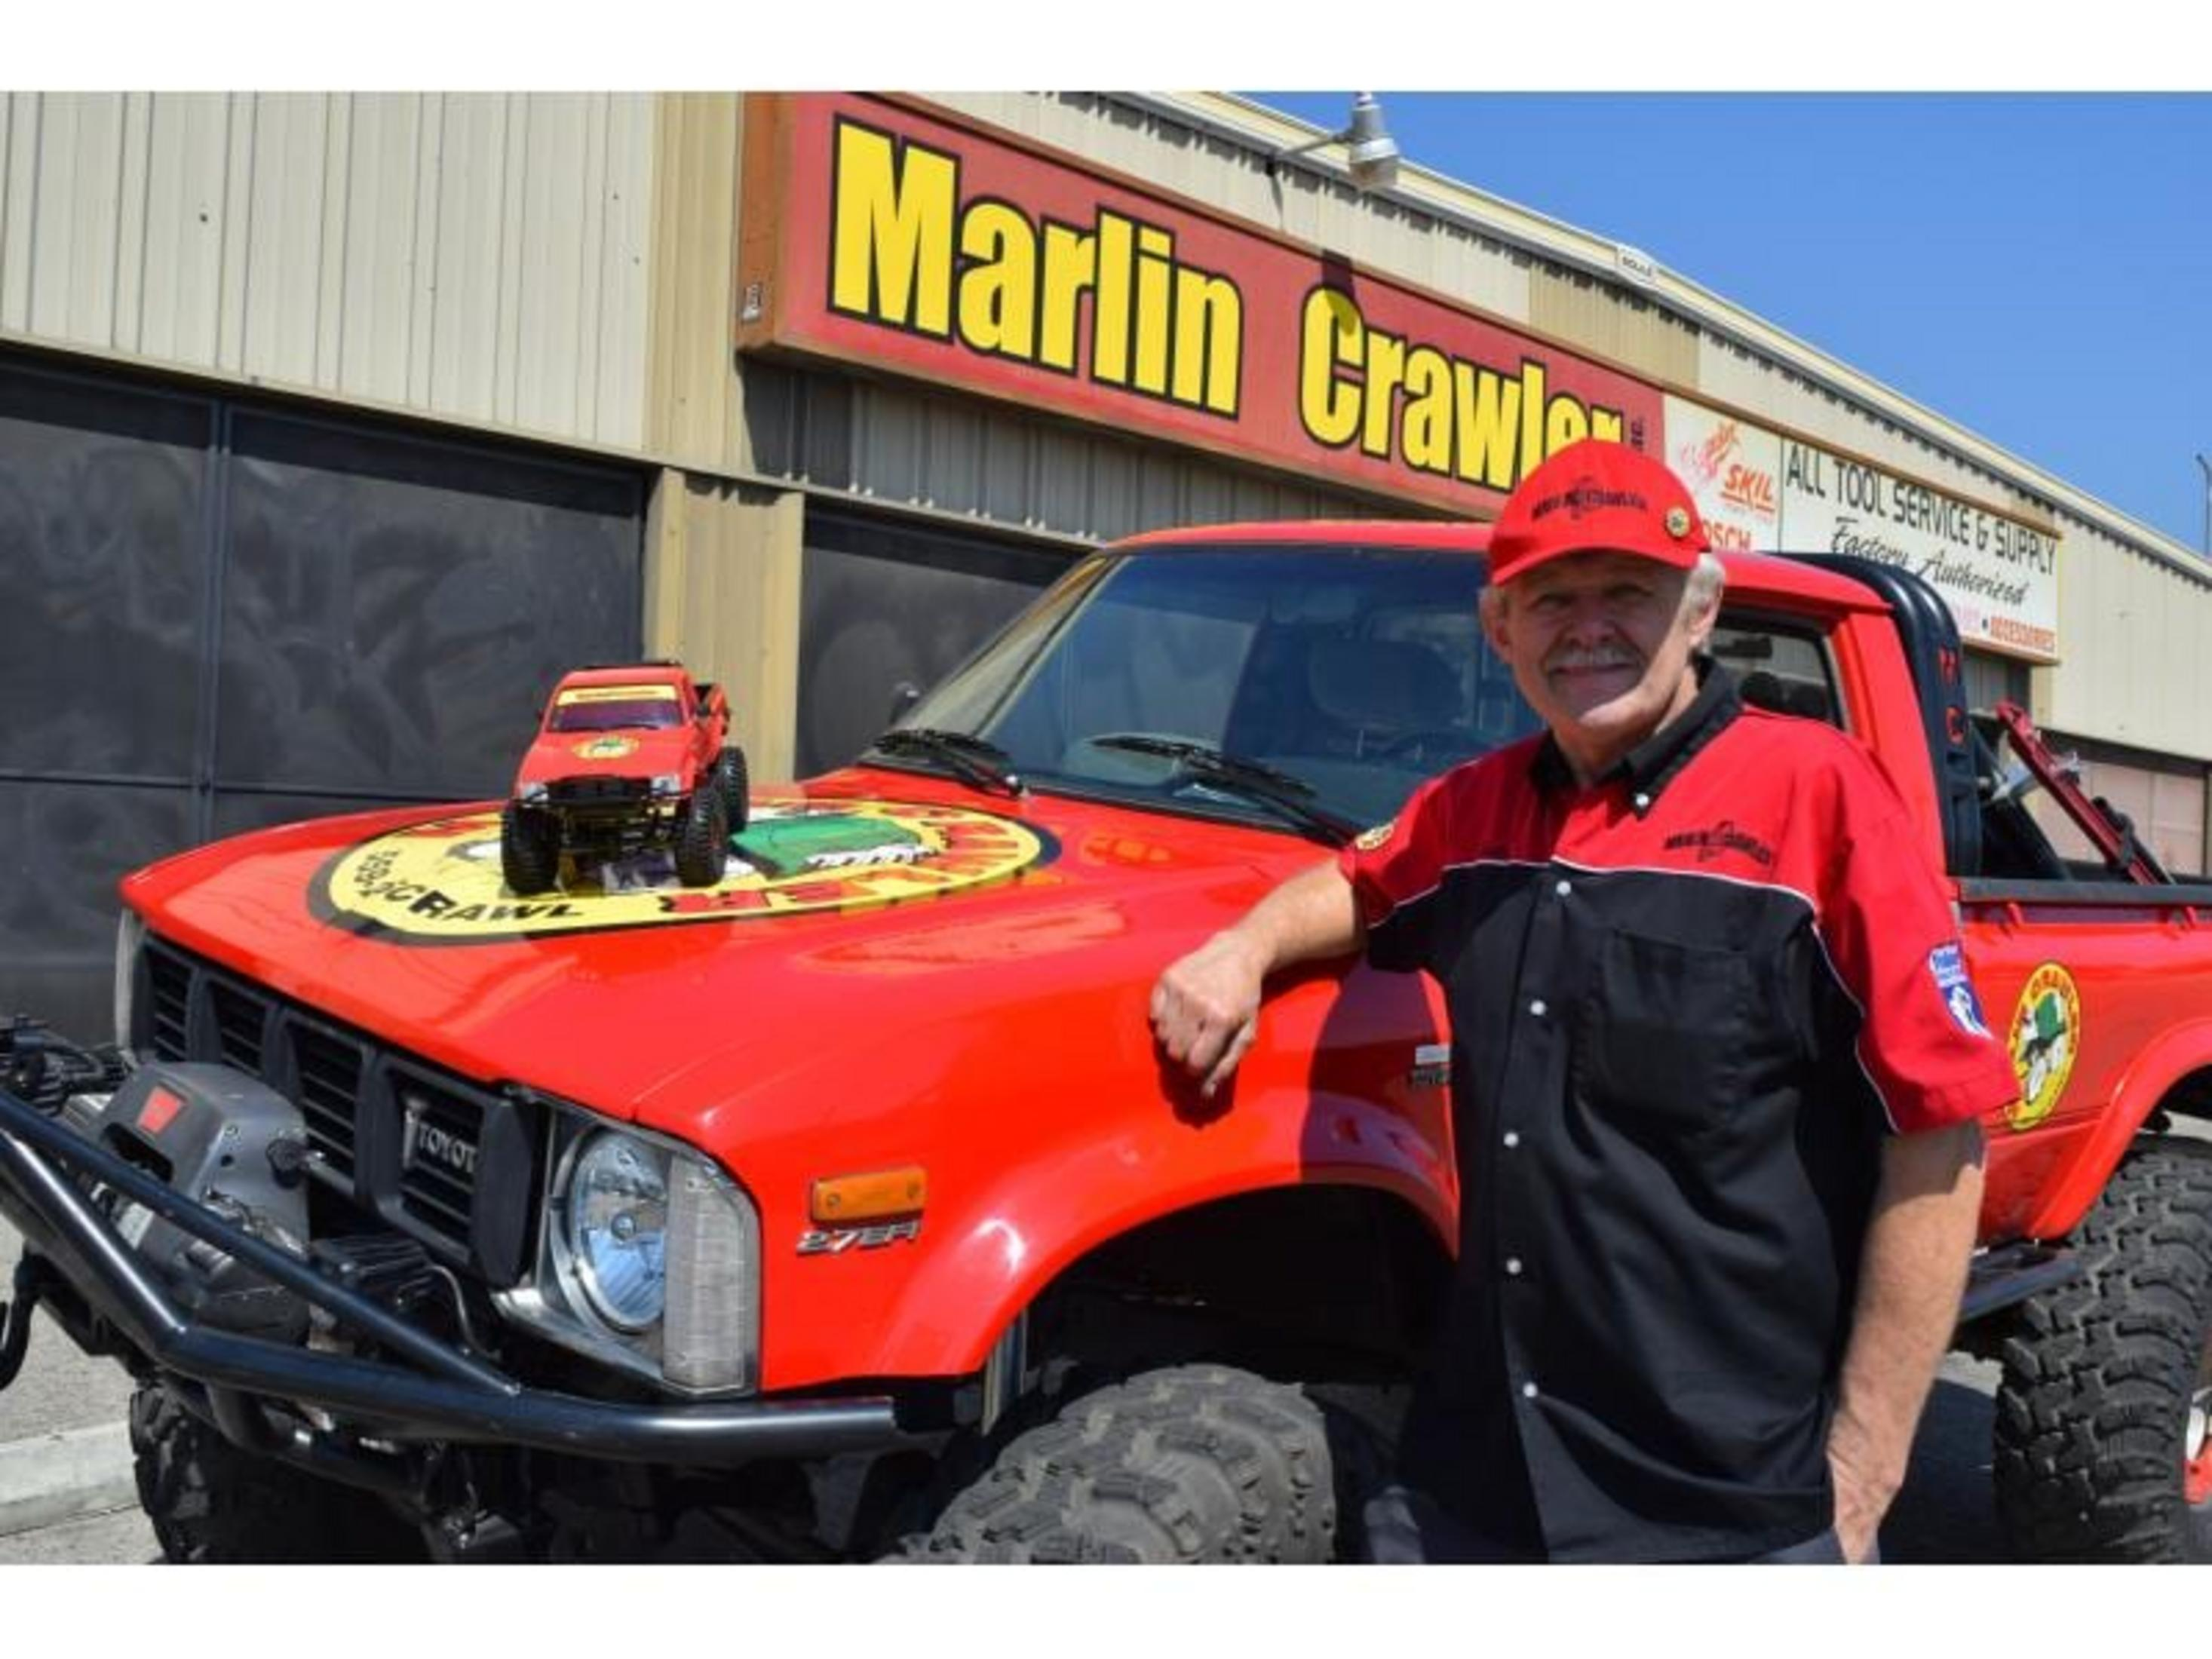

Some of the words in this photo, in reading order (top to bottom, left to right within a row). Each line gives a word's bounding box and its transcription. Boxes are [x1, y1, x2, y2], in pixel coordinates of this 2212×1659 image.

[827, 111, 1244, 421] Marlin
[1724, 463, 1774, 508] SKIL
[1786, 442, 1826, 498] ALL
[1833, 459, 1888, 518] TOOL
[1893, 477, 1970, 546] SERVICE
[1995, 515, 2057, 575] SUPPLY
[1702, 518, 1751, 550] OSCH
[1830, 516, 1909, 567] Factory
[419, 1121, 478, 1173] TOYOT
